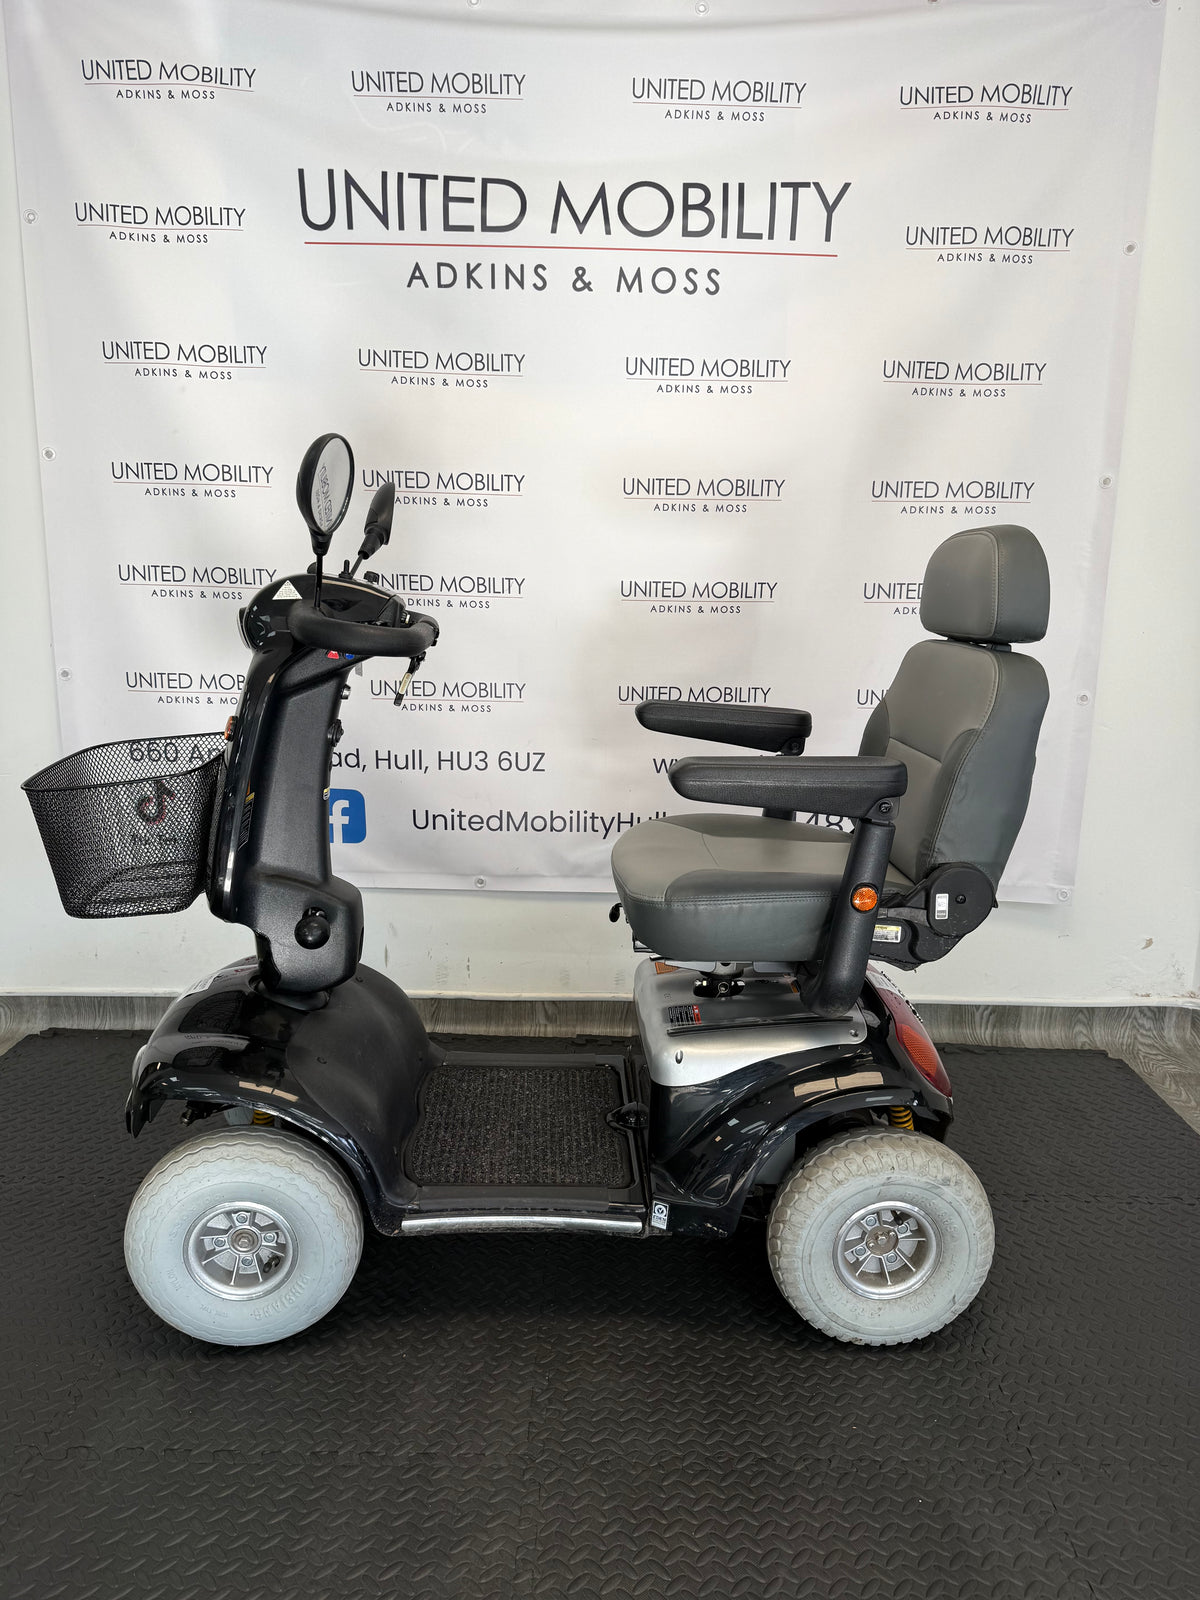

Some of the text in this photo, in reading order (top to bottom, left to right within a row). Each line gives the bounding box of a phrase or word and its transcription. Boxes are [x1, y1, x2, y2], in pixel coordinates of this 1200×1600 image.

[81, 59, 257, 89] UNITED MOBILITY
[351, 70, 526, 96] UNITED MOBILITY
[115, 88, 215, 100] ADKINS & MOSS
[632, 77, 807, 104] UNITED MOBILITY
[899, 82, 1074, 108] UNITED MOBILITY
[386, 101, 487, 114] ADKINS & MOSS
[664, 109, 765, 122] ADKINS & MOSS
[933, 110, 1032, 124] ADKINS & MOSS
[74, 201, 246, 227] UNITED MOBILITY
[297, 167, 852, 243] UNITED MOBILITY
[109, 230, 209, 244] ADKINS & MOSS
[905, 225, 1075, 248] UNITED MOBILITY
[936, 252, 1033, 265] ADKINS & MOSS
[406, 261, 721, 296] ADKINS & MOSS
[101, 340, 268, 366] UNITED MOBILITY
[358, 348, 526, 373] UNITED MOBILITY
[134, 367, 233, 381] ADKINS & MOSS
[625, 356, 792, 378] UNITED MOBILITY
[883, 359, 1047, 382] UNITED MOBILITY
[390, 375, 489, 389] ADKINS & MOSS
[656, 383, 753, 395] ADKINS & MOSS
[911, 386, 1006, 398] ADKINS & MOSS
[111, 461, 274, 484] UNITED MOBILITY
[362, 469, 526, 493] UNITED MOBILITY
[144, 487, 237, 498] ADKINS & MOSS
[622, 477, 786, 498] UNITED MOBILITY
[871, 480, 1035, 500] UNITED MOBILITY
[394, 495, 489, 508] ADKINS & MOSS
[653, 502, 747, 513] ADKINS & MOSS
[900, 505, 997, 515] ADKINS & MOSS
[118, 563, 278, 586] UNITED MOBILITY
[151, 588, 243, 601] ADKINS & MOSS
[439, 575, 526, 595] MOBILITY
[620, 580, 778, 599] UNITED MOBILITY
[407, 597, 490, 609] DKINS & MOSS
[649, 604, 741, 614] ADKINS & MOSS
[893, 606, 920, 615] ADK
[125, 671, 193, 692] UNITED
[370, 679, 437, 697] UNED
[442, 681, 527, 700] MOBILITY
[157, 695, 239, 706] ADKINS & MO
[618, 685, 772, 704] UNITED MOBILITY
[400, 703, 492, 713] ADKINS & MOSS
[375, 748, 429, 775] Hull,
[437, 750, 489, 772] HU3
[497, 750, 546, 772] 6UZ
[412, 808, 667, 840] UnitedMobilityH
